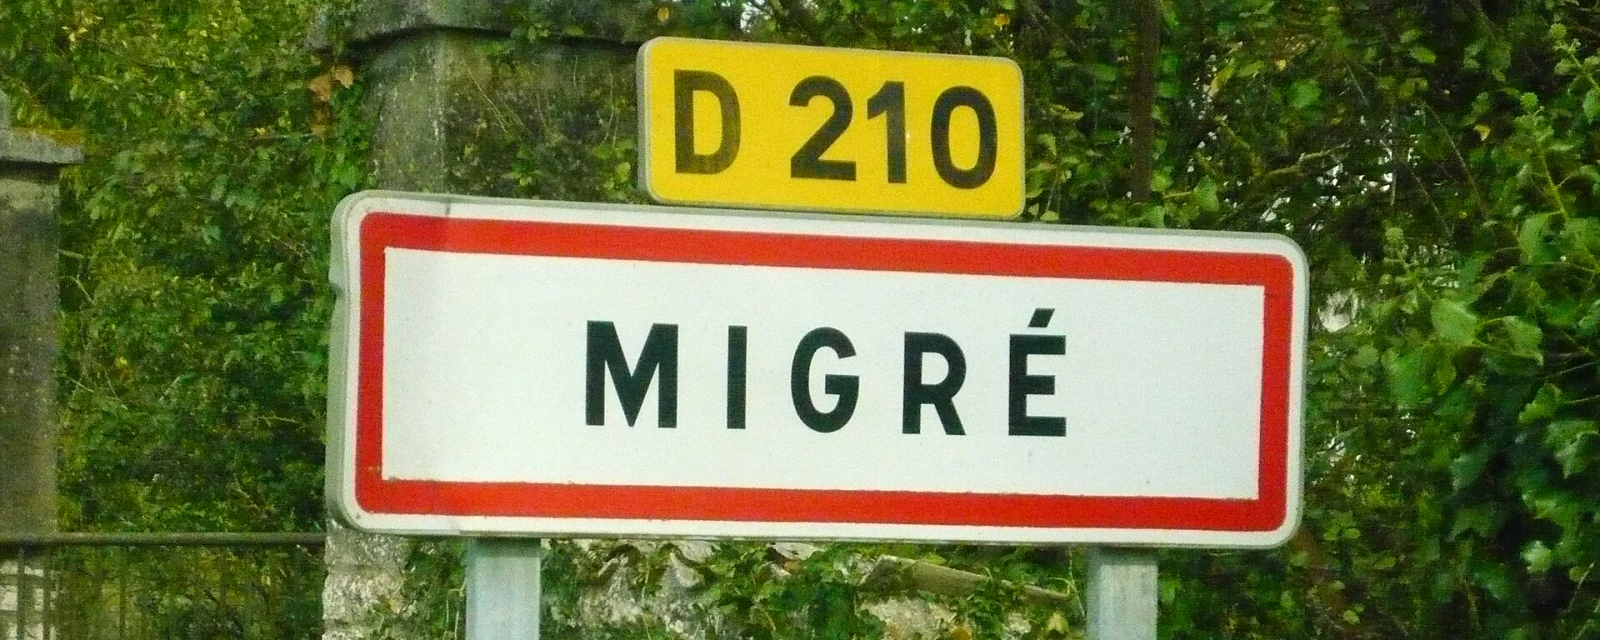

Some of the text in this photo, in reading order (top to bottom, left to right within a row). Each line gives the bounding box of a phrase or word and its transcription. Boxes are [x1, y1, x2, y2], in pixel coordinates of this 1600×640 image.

[673, 69, 999, 191] D 210
[585, 308, 1068, 437] MIGRÉ
